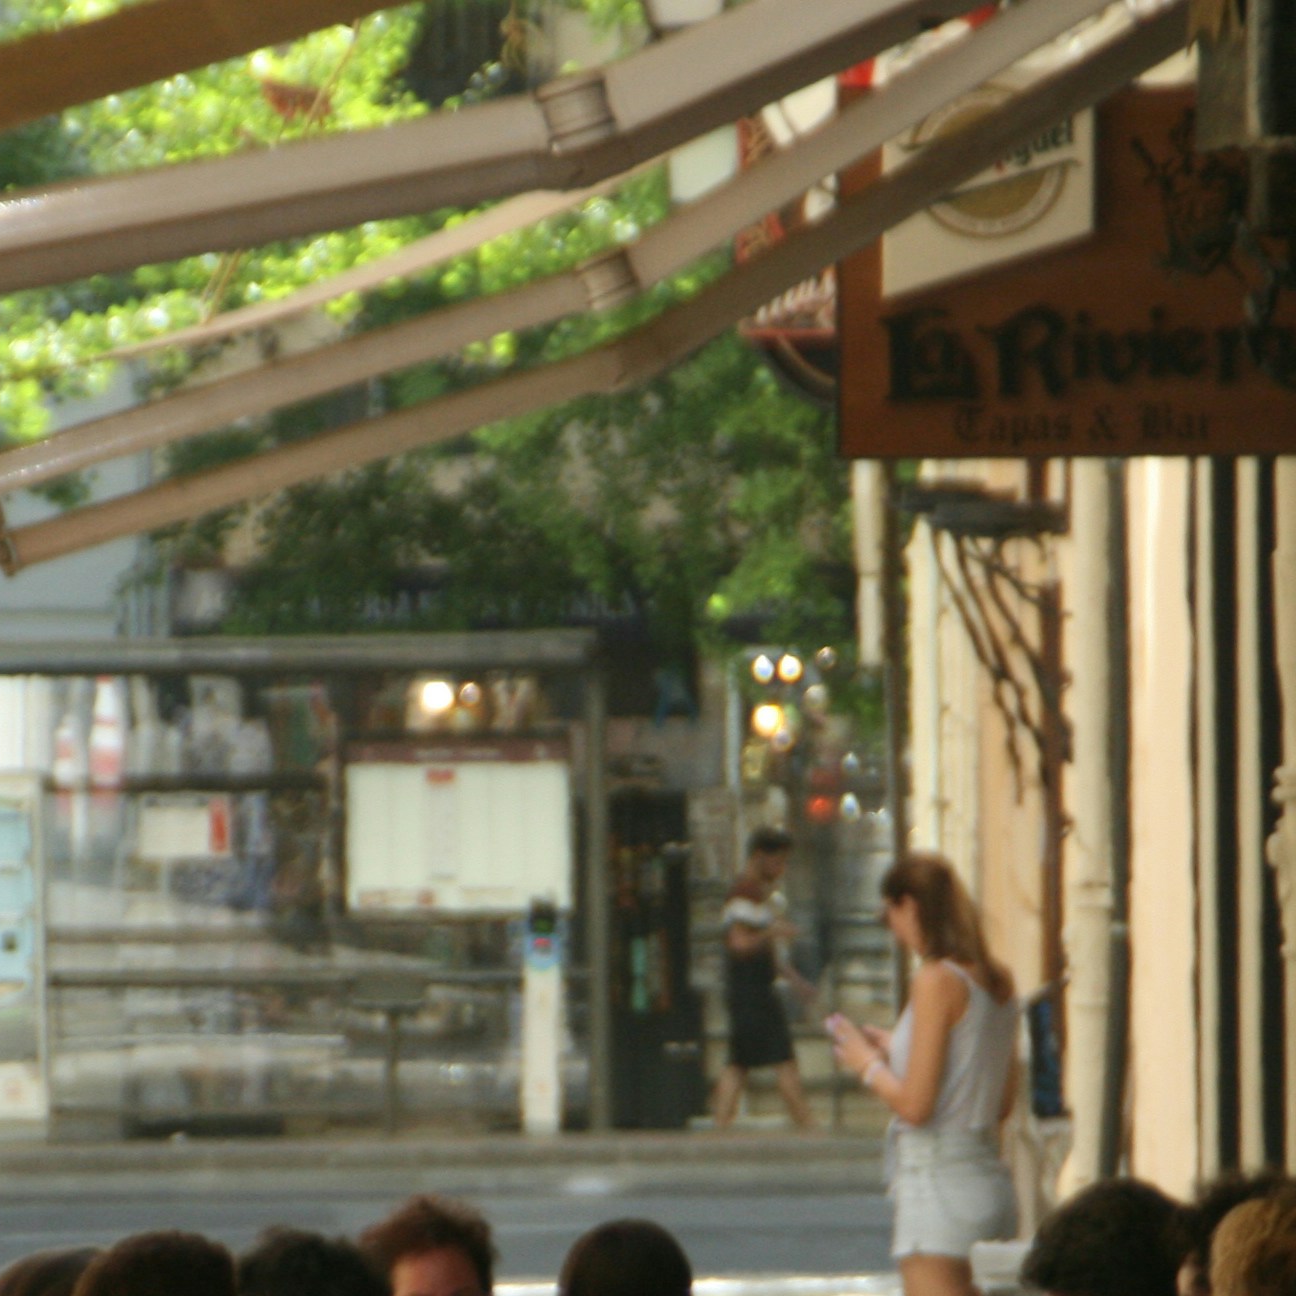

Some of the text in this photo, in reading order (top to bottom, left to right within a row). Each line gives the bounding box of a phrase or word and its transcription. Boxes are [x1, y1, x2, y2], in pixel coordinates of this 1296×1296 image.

[881, 306, 983, 403] La
[954, 403, 1211, 445] Tapas & Bar
